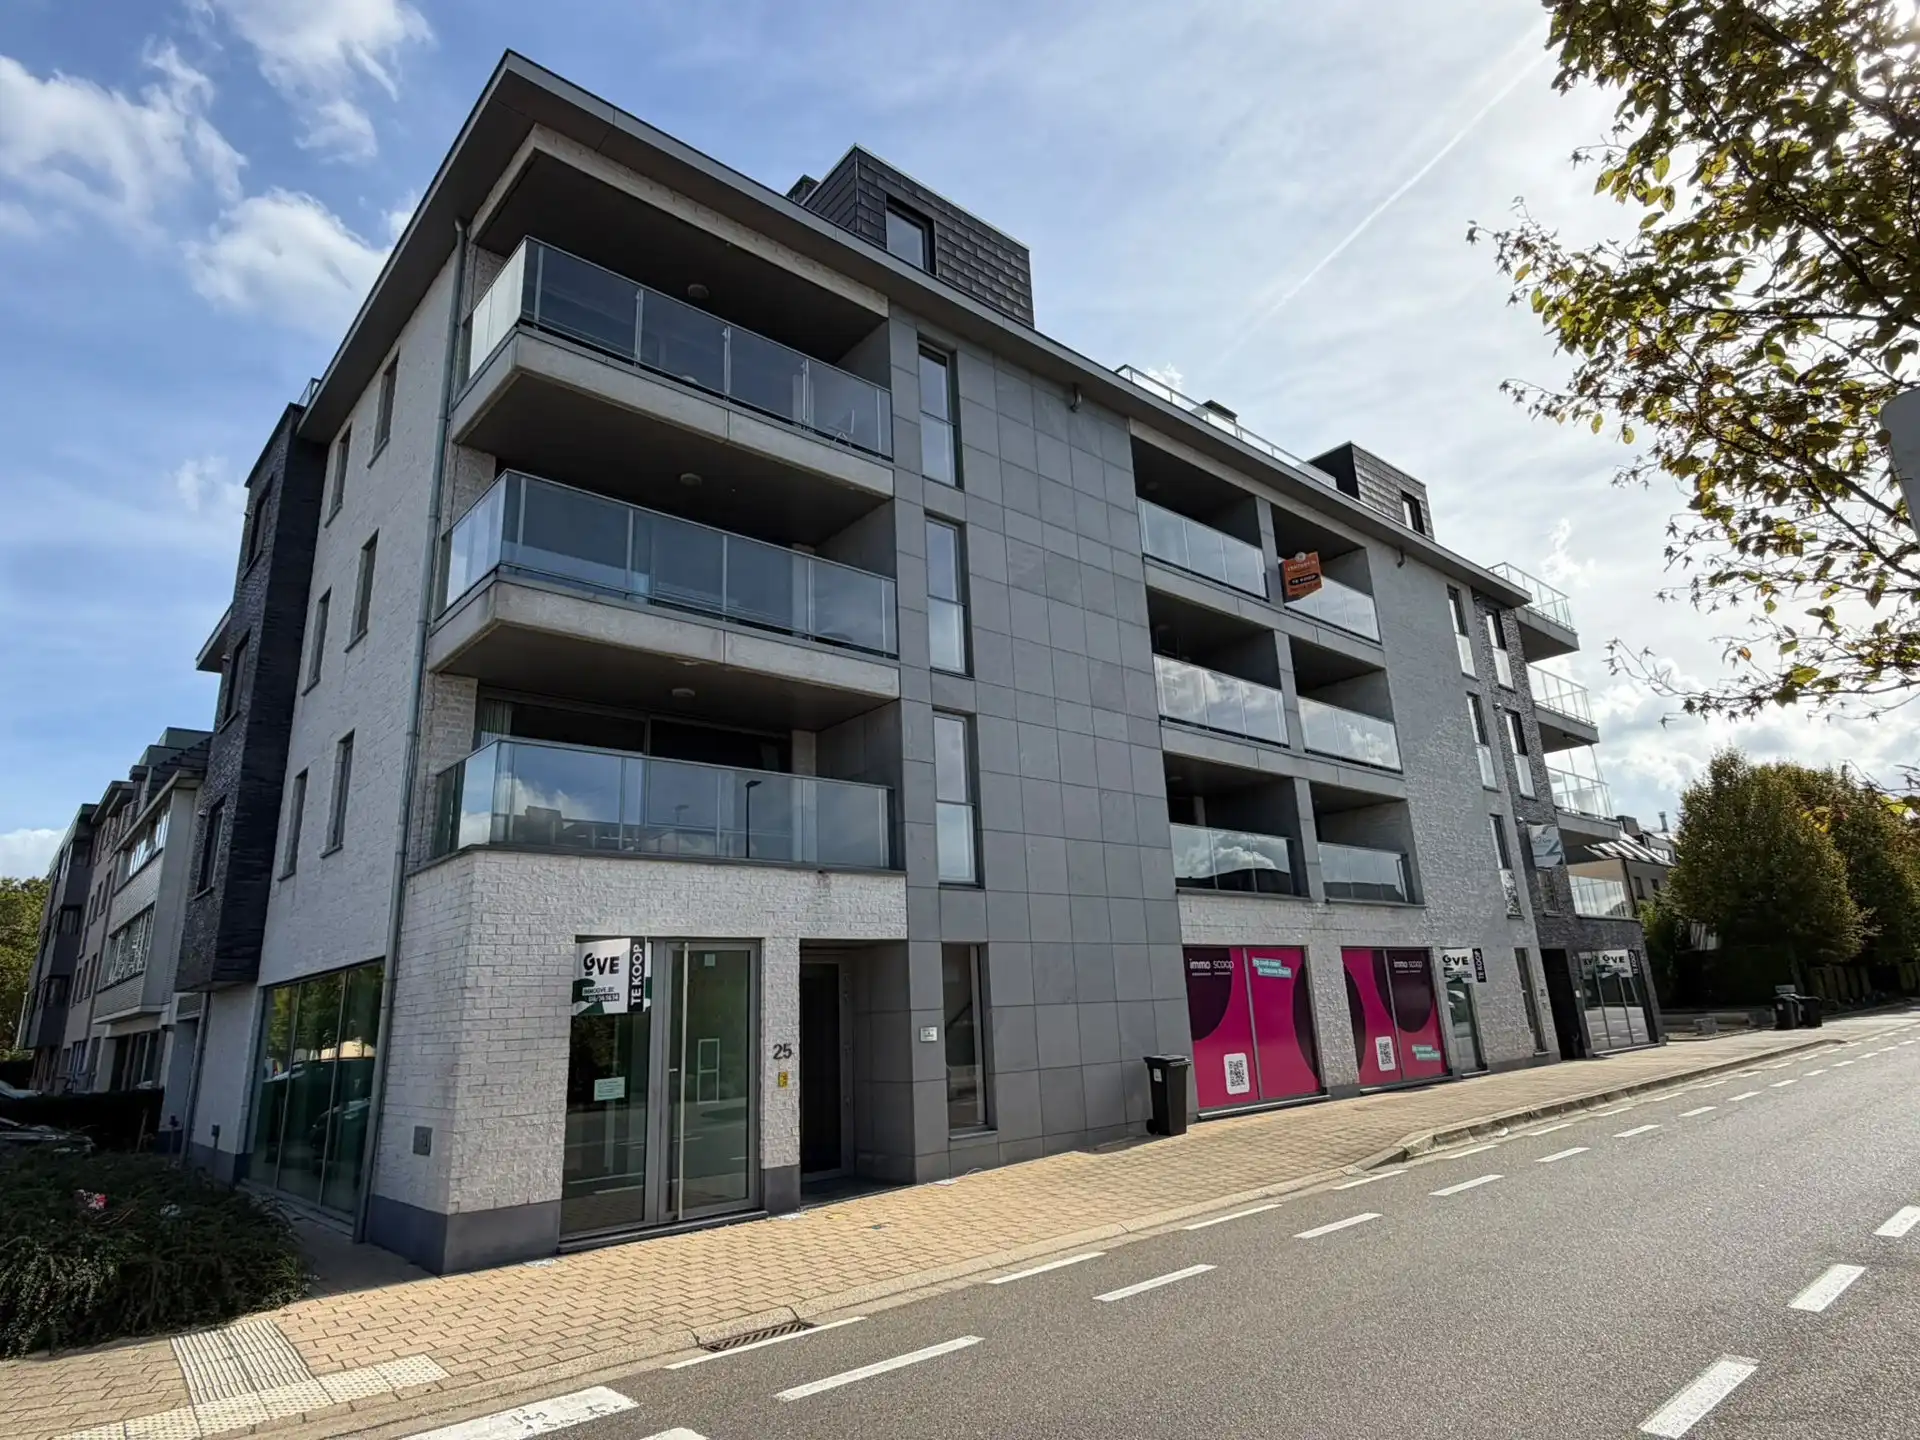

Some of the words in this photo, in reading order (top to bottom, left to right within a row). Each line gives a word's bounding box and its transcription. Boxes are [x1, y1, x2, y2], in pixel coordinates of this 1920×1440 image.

[631, 944, 643, 986] KOOP
[1189, 958, 1211, 969] immo
[1213, 960, 1234, 971] scoop
[630, 988, 642, 1006] TE
[773, 1043, 792, 1059] 25
